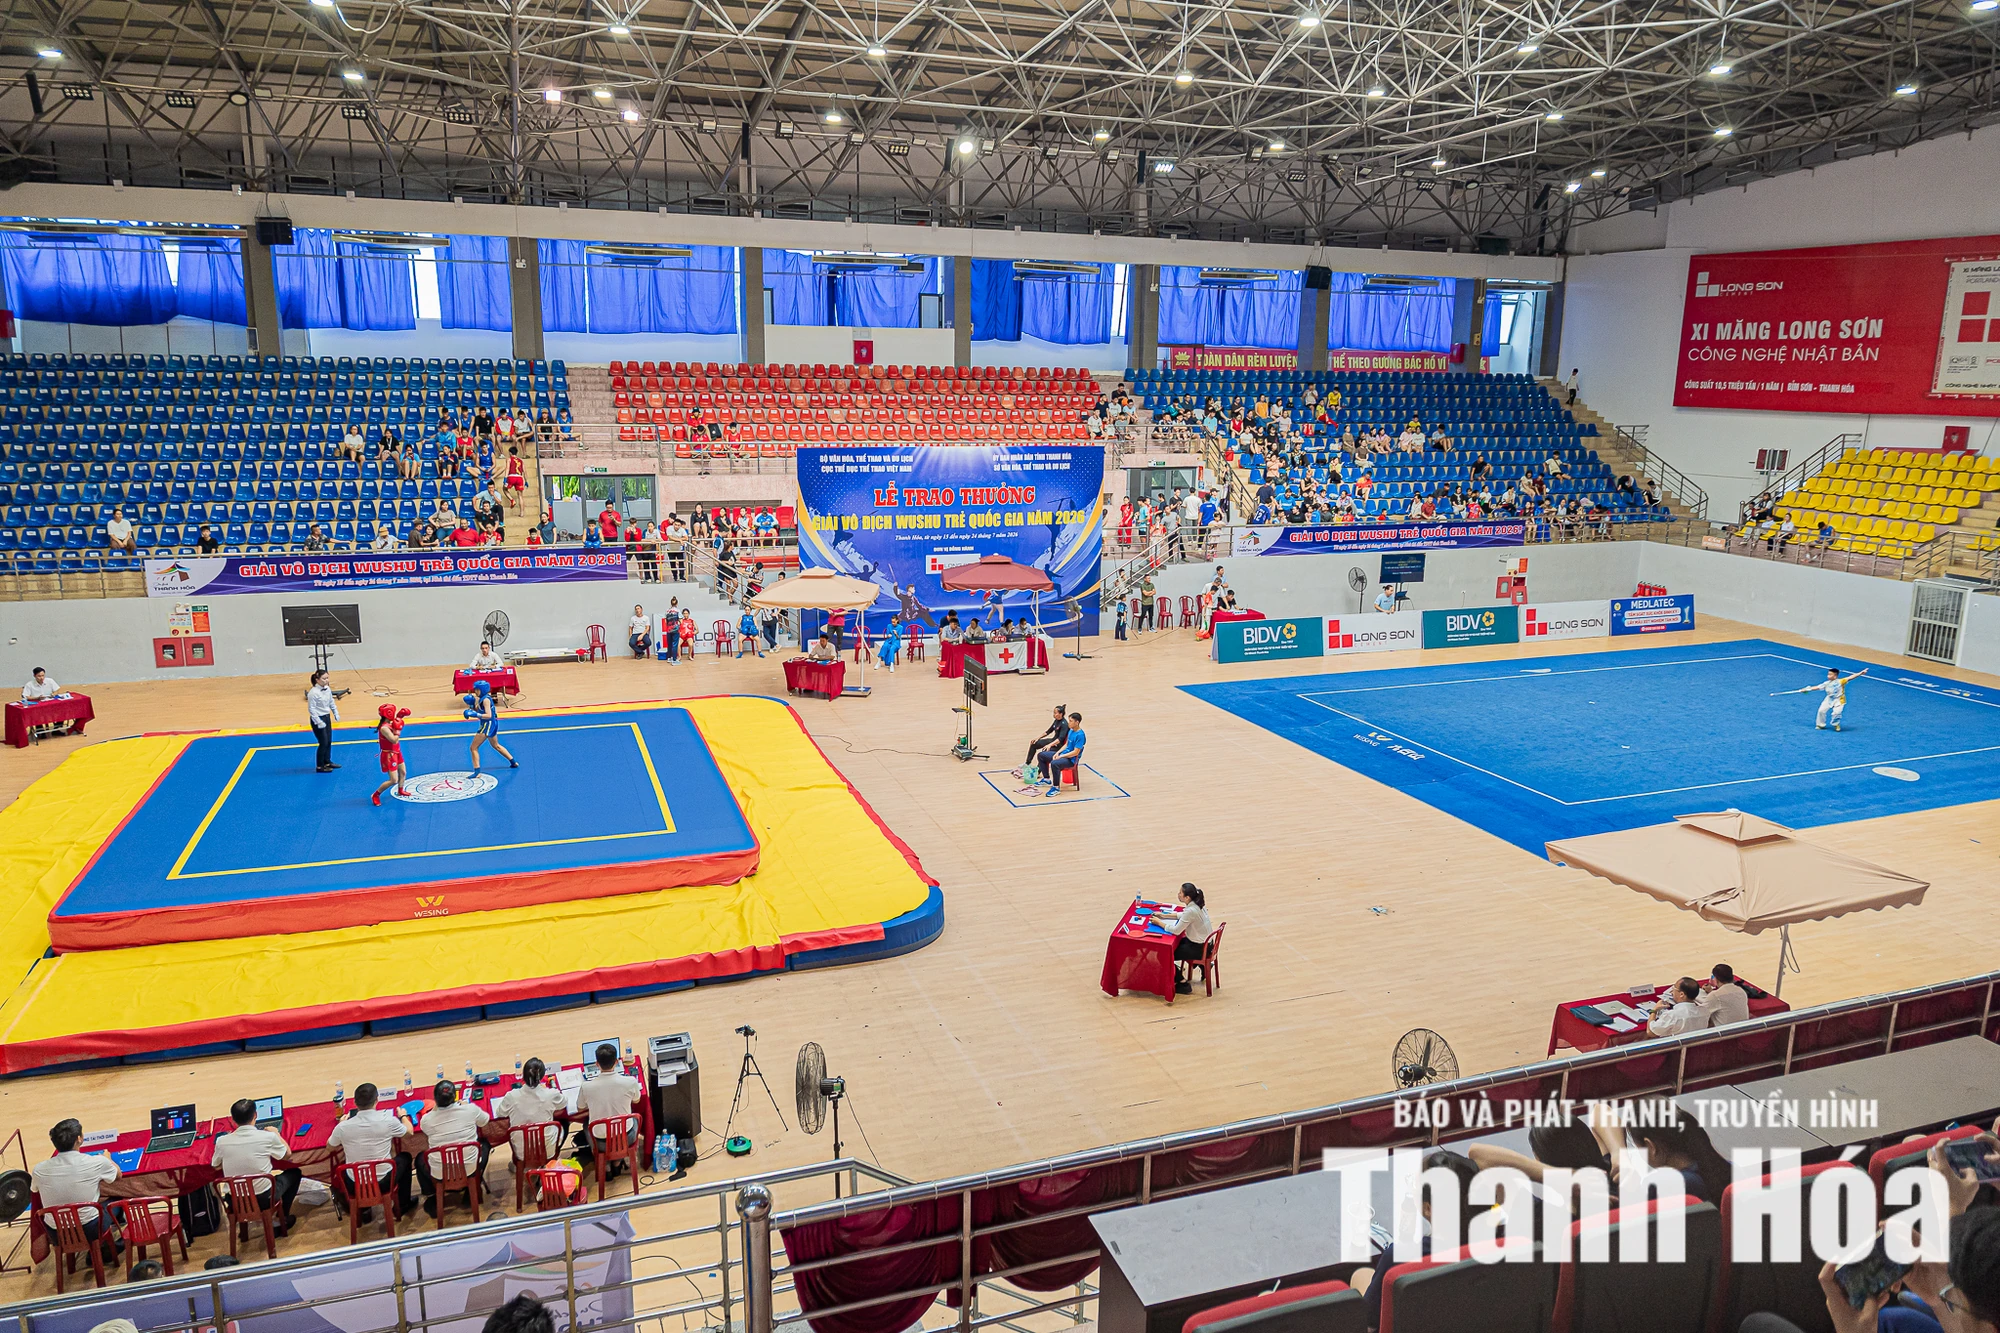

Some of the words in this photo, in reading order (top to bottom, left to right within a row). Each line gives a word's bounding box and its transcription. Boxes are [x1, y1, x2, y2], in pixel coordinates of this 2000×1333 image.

[1720, 282, 1754, 292] LONG
[1690, 323, 1709, 340] XI
[1716, 318, 1771, 340] MĂNG
[1778, 320, 1832, 340] LONG
[1839, 316, 1884, 339] SƠN
[1196, 352, 1222, 367] TOÀN
[1224, 352, 1246, 367] DÂN
[1248, 352, 1266, 367] RÈN
[1270, 353, 1298, 370] LUYỆN
[1331, 352, 1346, 368] HỂ
[1348, 356, 1370, 368] THEO
[1372, 356, 1400, 369] GƯƠNG
[1404, 355, 1422, 370] BÁC
[1424, 355, 1436, 370] HỒ
[1437, 357, 1446, 370] VĨ
[1688, 346, 1737, 361] CÔNG
[1742, 344, 1787, 364] NGHỆ
[1792, 344, 1838, 364] NHẬT
[1842, 342, 1880, 361] BẢN
[1684, 380, 1699, 388] CÔNG
[1700, 379, 1714, 389] SUẤT
[1728, 380, 1744, 392] TRIỆU
[1745, 380, 1756, 390] TẤN
[1766, 381, 1780, 390] NĂM
[1800, 382, 1813, 392] SƠN
[1819, 384, 1840, 392] THANH
[1841, 383, 1855, 393] HÓA
[830, 454, 840, 462] VĂN
[856, 453, 866, 462] THỂ
[883, 454, 891, 462] VÀ
[892, 454, 900, 462] DU
[900, 454, 914, 464] LỊCH
[821, 465, 834, 474] CỤC
[834, 464, 846, 472] THỂ
[860, 464, 870, 472] THỂ
[886, 464, 898, 474] VIỆT
[874, 481, 898, 507] LỄ
[904, 488, 954, 507] TRAO
[960, 482, 1036, 506] THƯỞNG
[812, 513, 838, 530] GIẢI
[841, 513, 859, 530] VÔ
[862, 516, 892, 532] ĐỊCH
[896, 514, 941, 530] WUSHU
[944, 511, 966, 528] TRẺ
[969, 509, 1001, 528] QUỐC
[1004, 512, 1024, 526] GIA
[1027, 510, 1052, 526] NĂM
[1055, 510, 1086, 524] 2026
[978, 532, 992, 540] tháng
[1290, 530, 1312, 542] GIẢI
[1315, 530, 1331, 541] VÔ
[1332, 530, 1356, 542] ĐỊCH
[1358, 528, 1396, 540] WUSHU
[1399, 526, 1420, 538] TRẺ
[1420, 525, 1447, 538] QUỐC
[1450, 526, 1467, 536] GIA
[1469, 524, 1493, 536] NĂM
[239, 562, 278, 576] GIẢI
[280, 561, 304, 575] VÔ
[308, 562, 350, 576] ĐỊCH
[354, 560, 416, 574] WUSHU
[420, 556, 454, 571] TRẺ
[457, 554, 500, 572] QUỐC
[504, 558, 532, 568] GIA
[535, 554, 574, 568] NĂM
[578, 554, 622, 566] 2026!
[1631, 598, 1674, 609] MEDLATEC
[1446, 614, 1482, 632] BIDV
[1549, 620, 1578, 630] LONG
[1581, 618, 1604, 628] SON
[695, 632, 736, 641] LOG
[1243, 626, 1282, 644] BIDV
[1354, 632, 1388, 642] LONG
[1390, 630, 1414, 640] SON
[414, 908, 449, 918] WESING
